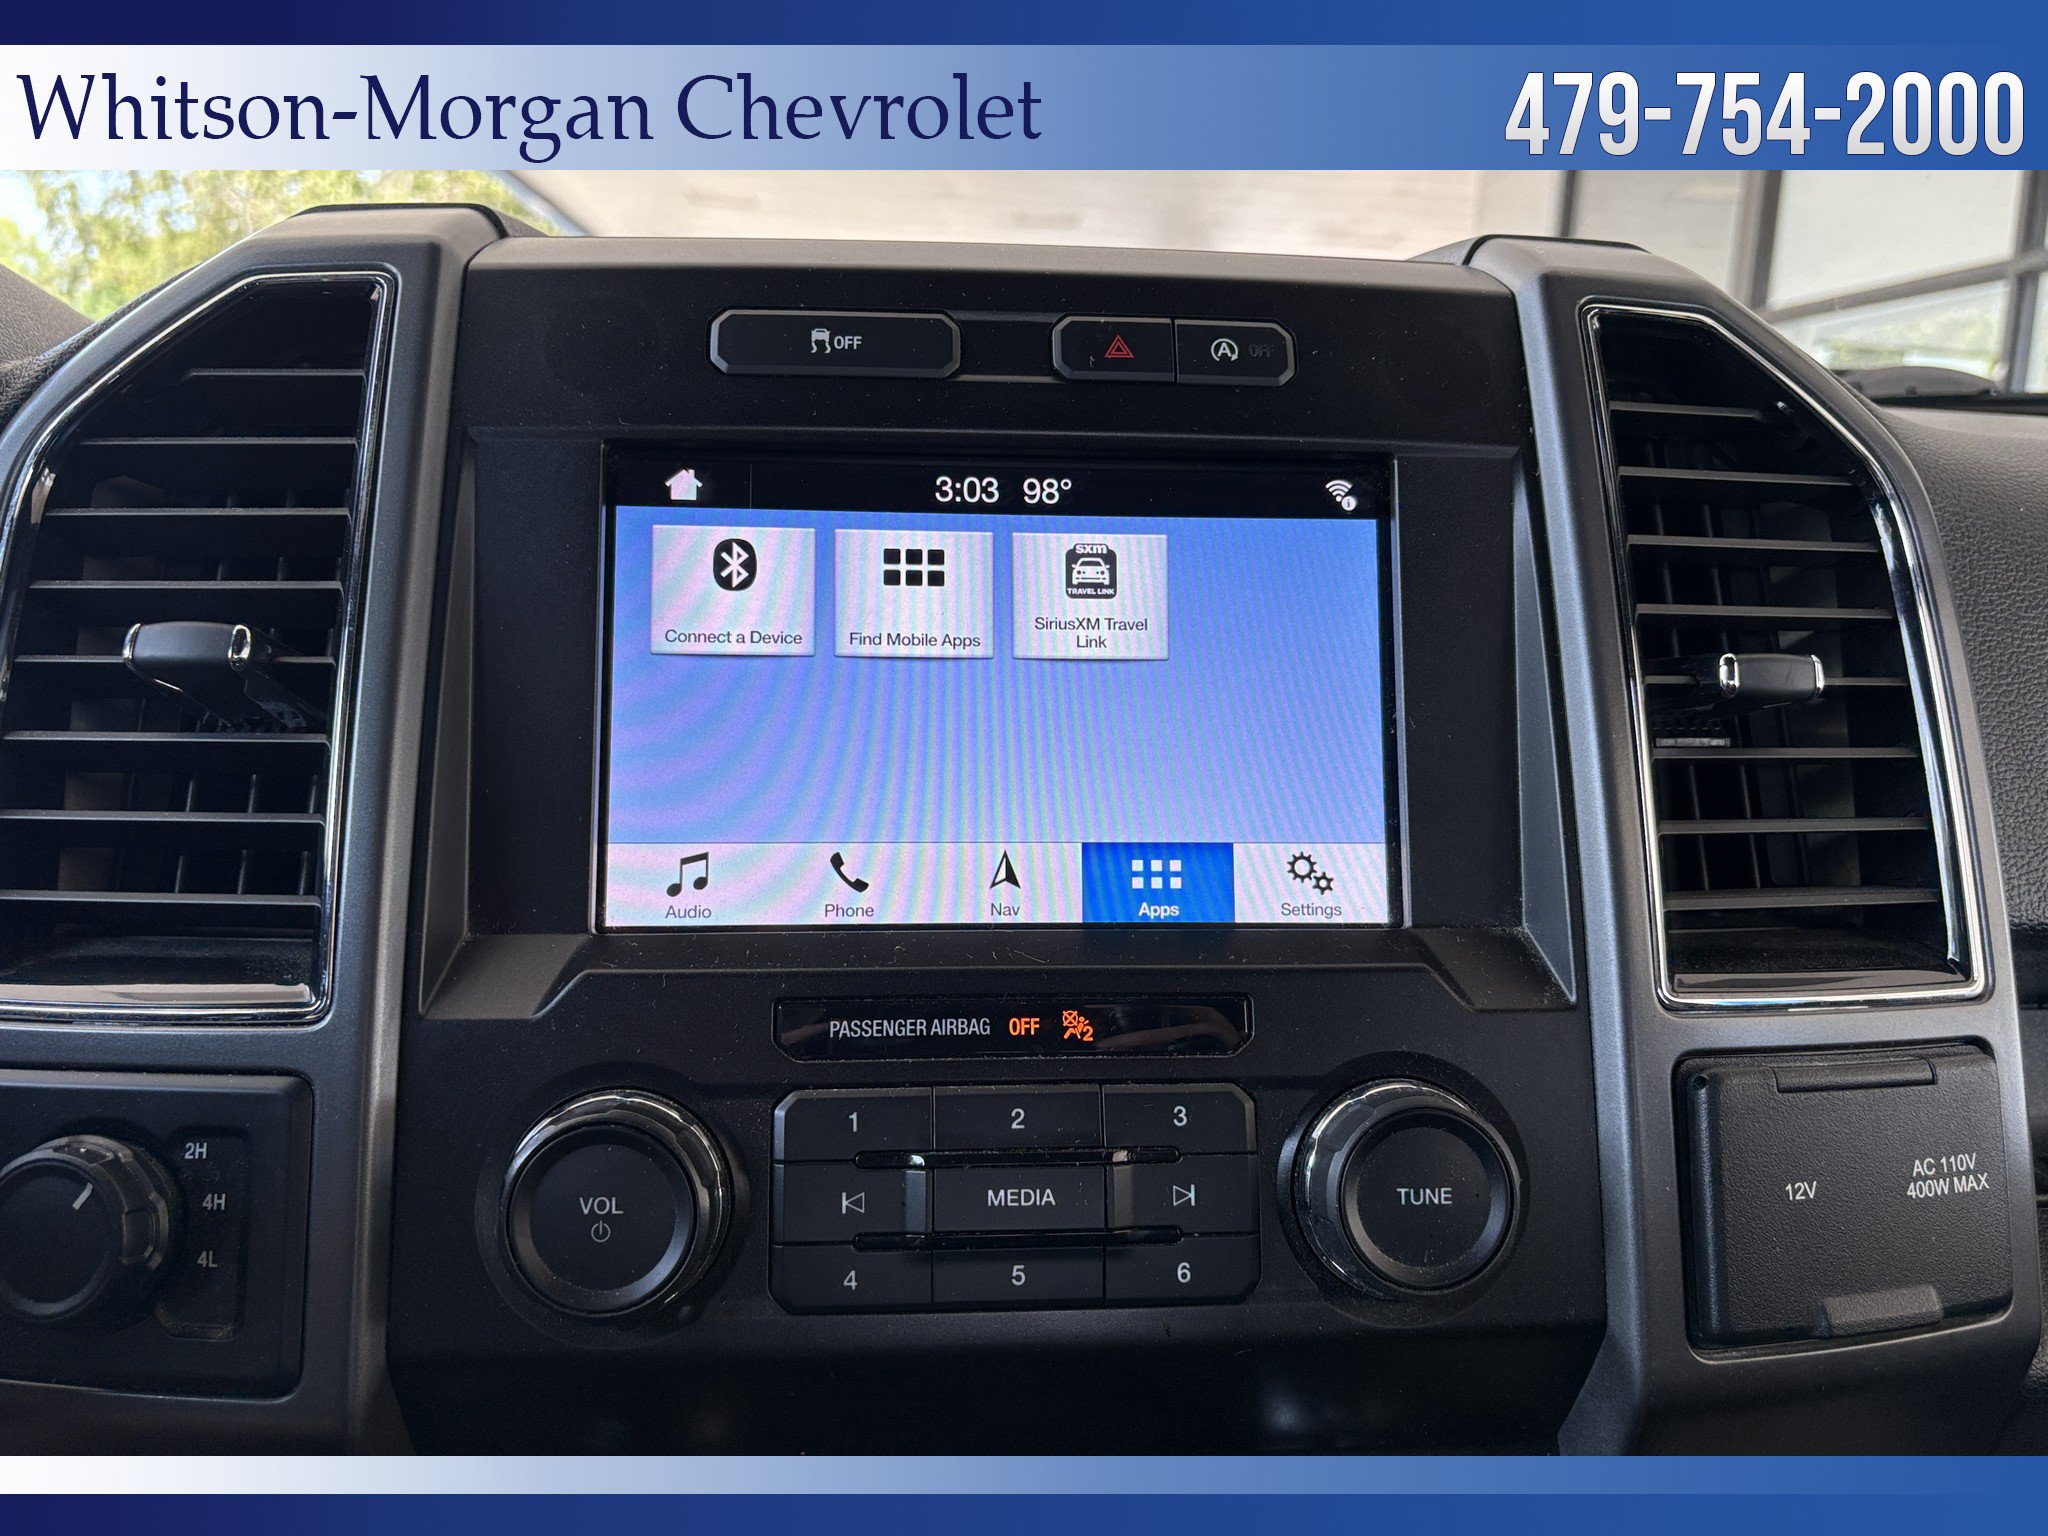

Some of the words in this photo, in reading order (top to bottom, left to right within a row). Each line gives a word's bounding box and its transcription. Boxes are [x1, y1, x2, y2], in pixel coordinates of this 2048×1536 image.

[834, 336, 862, 350] OFF
[935, 477, 999, 503] 3:03
[1023, 477, 1072, 504] 98°
[1034, 616, 1100, 631] SiriusXM
[1104, 617, 1148, 631] Travel
[664, 629, 732, 643] Connect
[735, 633, 746, 644] a
[750, 630, 803, 645] Device
[849, 632, 882, 646] Find
[886, 632, 938, 646] Mobile
[939, 633, 981, 650] Apps
[1076, 634, 1107, 648] Link
[665, 904, 712, 919] Audio
[824, 903, 874, 918] Phone
[990, 903, 1020, 917] Nav
[1138, 903, 1179, 921] Apps
[1281, 902, 1342, 919] Settings
[829, 1019, 927, 1038] PASSENGER
[931, 1018, 990, 1037] AIRBAG
[1009, 1017, 1039, 1035] OFF
[1083, 1026, 1094, 1041] 2
[848, 1112, 859, 1133] 1
[1011, 1108, 1025, 1130] 2
[1173, 1106, 1187, 1127] 3
[185, 1142, 207, 1160] 2H
[1913, 1157, 1935, 1175] AC
[1940, 1153, 1976, 1172] 110V
[1785, 1181, 1816, 1200] 12V
[1907, 1178, 1950, 1199] 400W
[1953, 1172, 1990, 1193] MAX
[203, 1194, 225, 1211] 4H
[987, 1187, 1056, 1208] MEDIA
[1396, 1187, 1452, 1206] TUNE
[580, 1197, 623, 1215] VOL
[198, 1251, 217, 1268] 4L
[843, 1270, 857, 1290] 4
[1011, 1264, 1025, 1286] 5
[1177, 1263, 1191, 1283] 6
